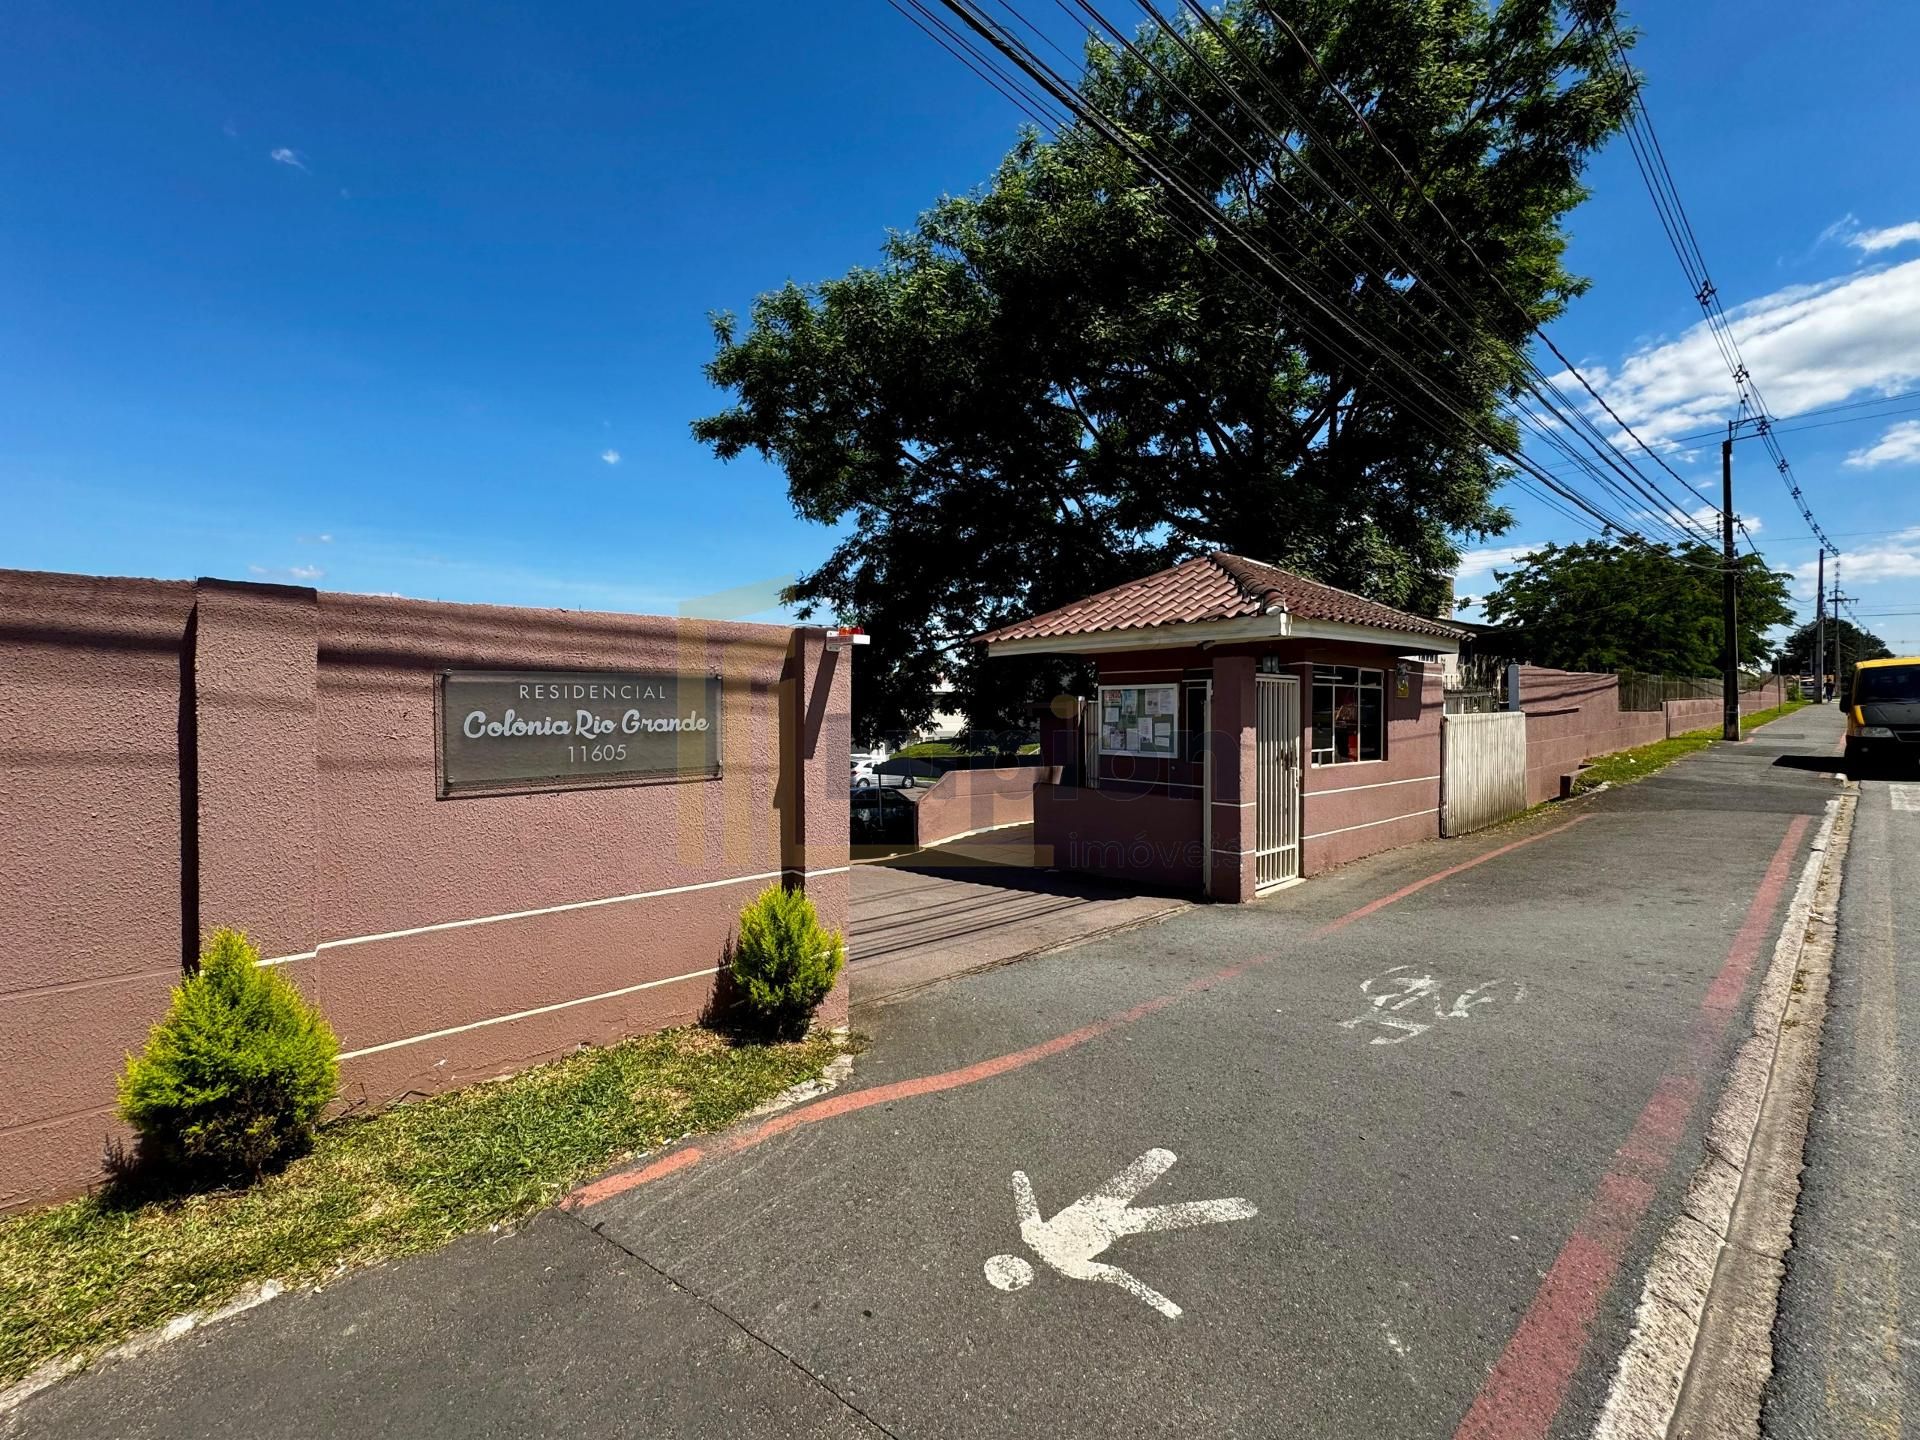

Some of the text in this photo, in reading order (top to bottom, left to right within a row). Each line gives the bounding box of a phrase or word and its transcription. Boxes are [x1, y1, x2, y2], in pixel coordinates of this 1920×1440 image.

[519, 684, 666, 700] RESIDENCIAL
[463, 709, 710, 740] Colônia Rio Grande
[567, 744, 628, 763] 11605
